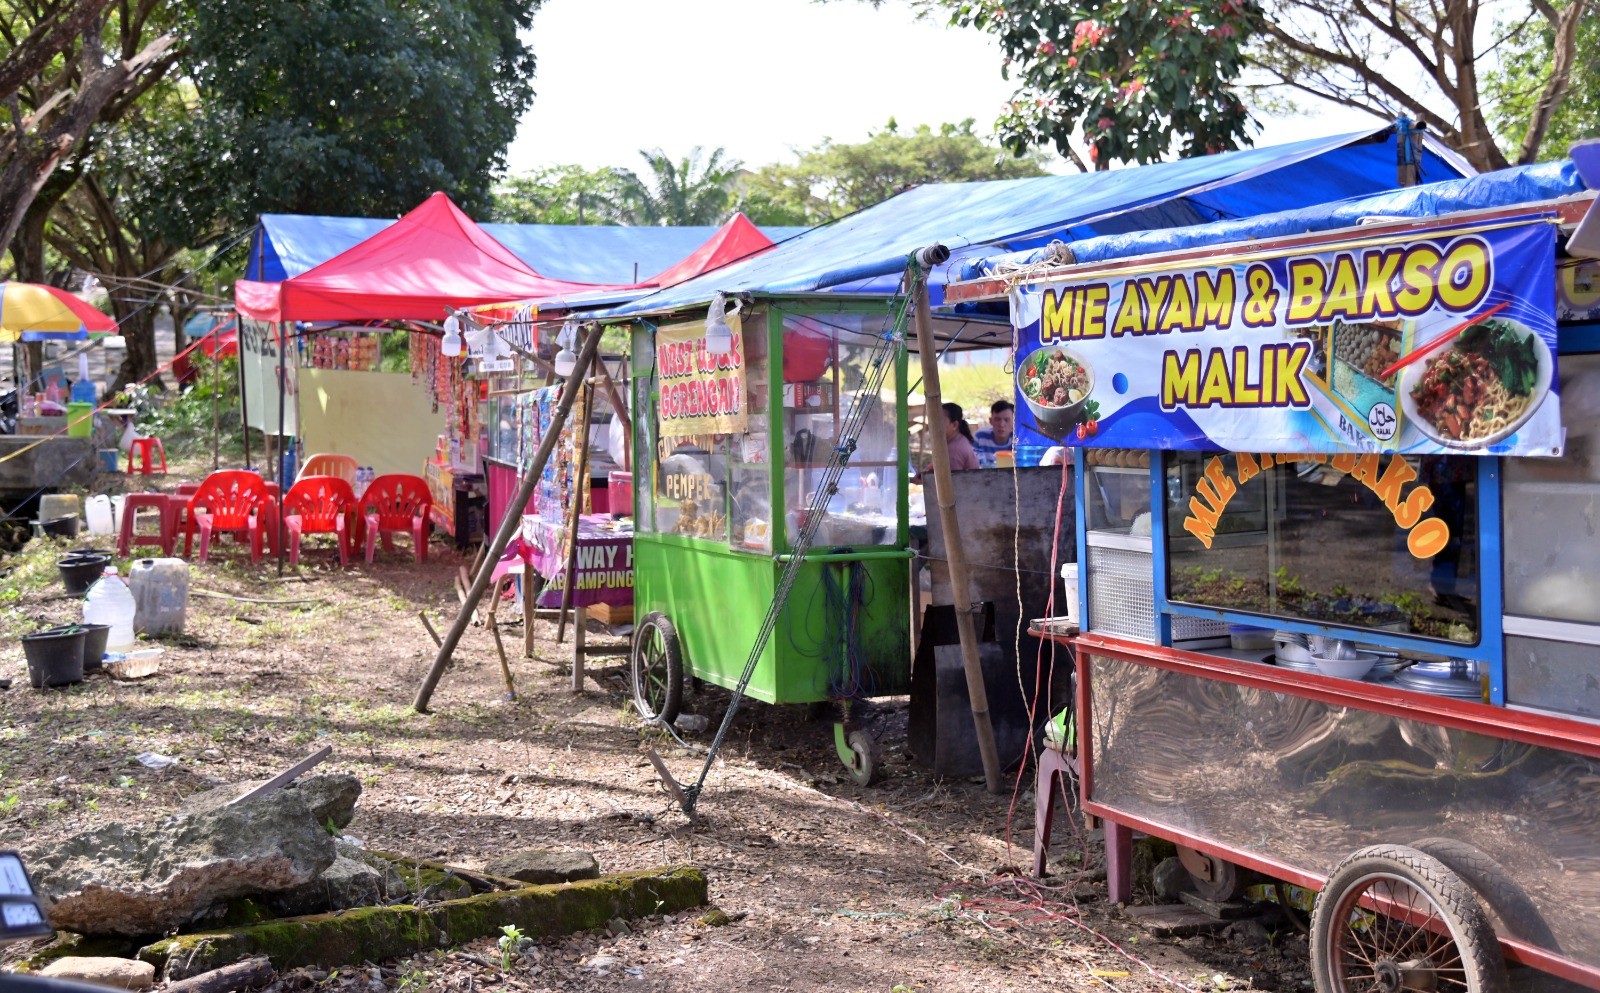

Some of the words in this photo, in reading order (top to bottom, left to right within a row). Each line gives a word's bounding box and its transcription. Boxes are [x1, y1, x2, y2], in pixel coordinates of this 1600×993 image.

[1041, 283, 1109, 342] MIE
[1111, 268, 1236, 337] AYAM
[1241, 264, 1279, 327] &
[1285, 237, 1491, 325] BAKSO
[658, 340, 694, 379] NASI
[1161, 341, 1312, 410] MALIK
[661, 376, 741, 420] GORENGAN
[666, 473, 711, 501] PEMPEK
[1183, 456, 1237, 549] MIE
